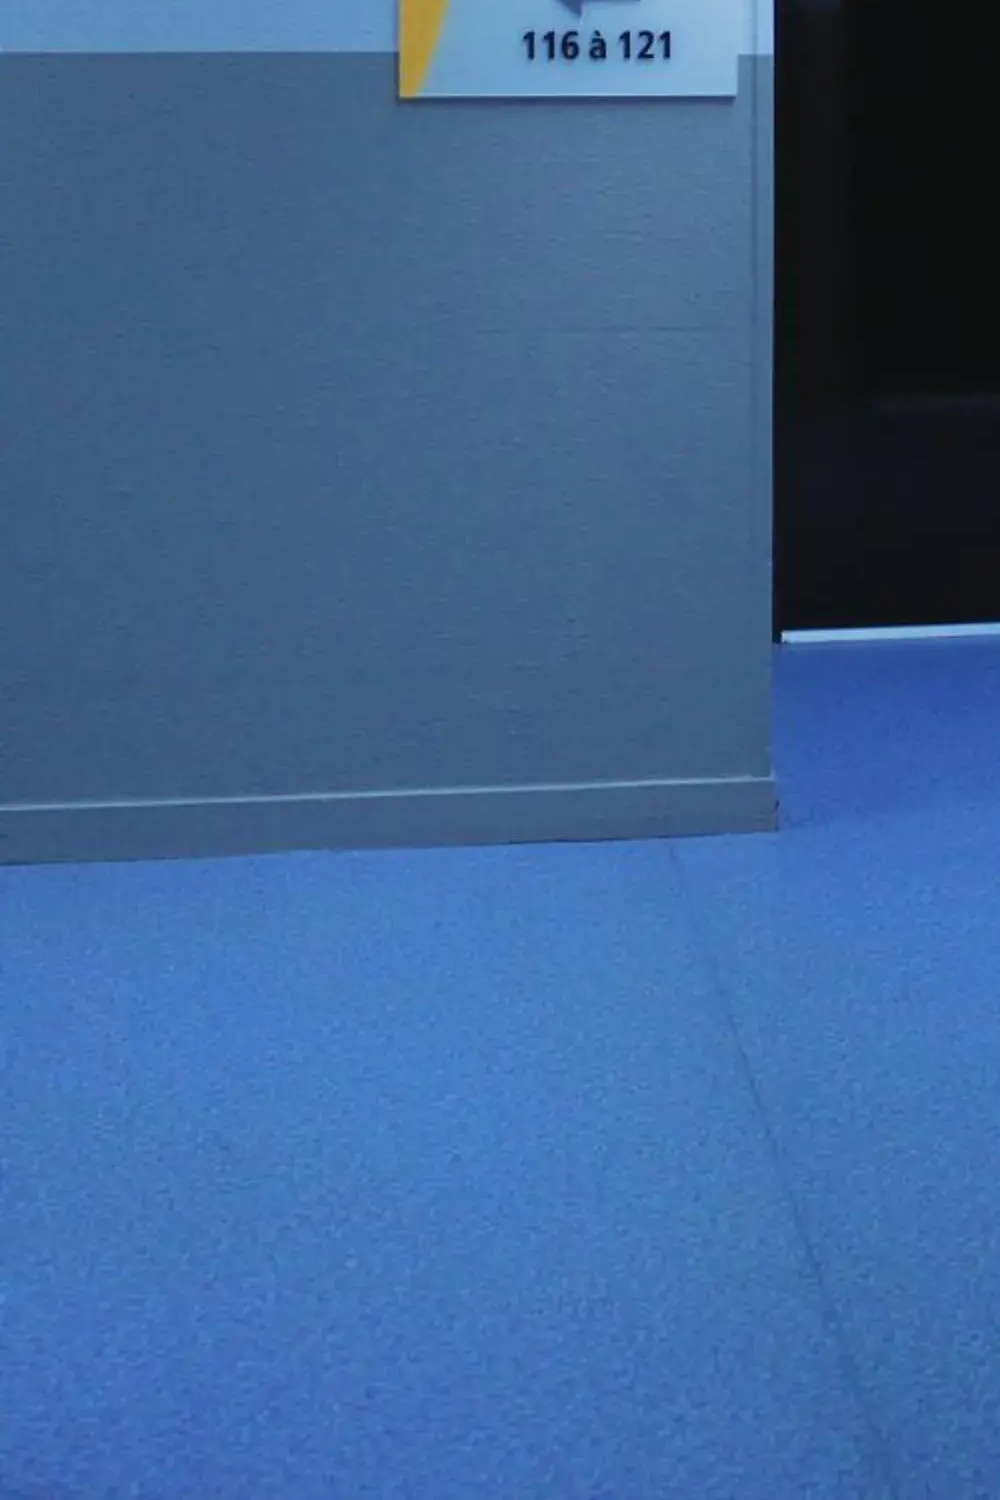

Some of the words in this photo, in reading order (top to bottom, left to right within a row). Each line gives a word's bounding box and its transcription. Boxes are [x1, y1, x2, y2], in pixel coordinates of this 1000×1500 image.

[522, 30, 580, 61] 116
[589, 30, 607, 61] à
[619, 30, 672, 60] 121
